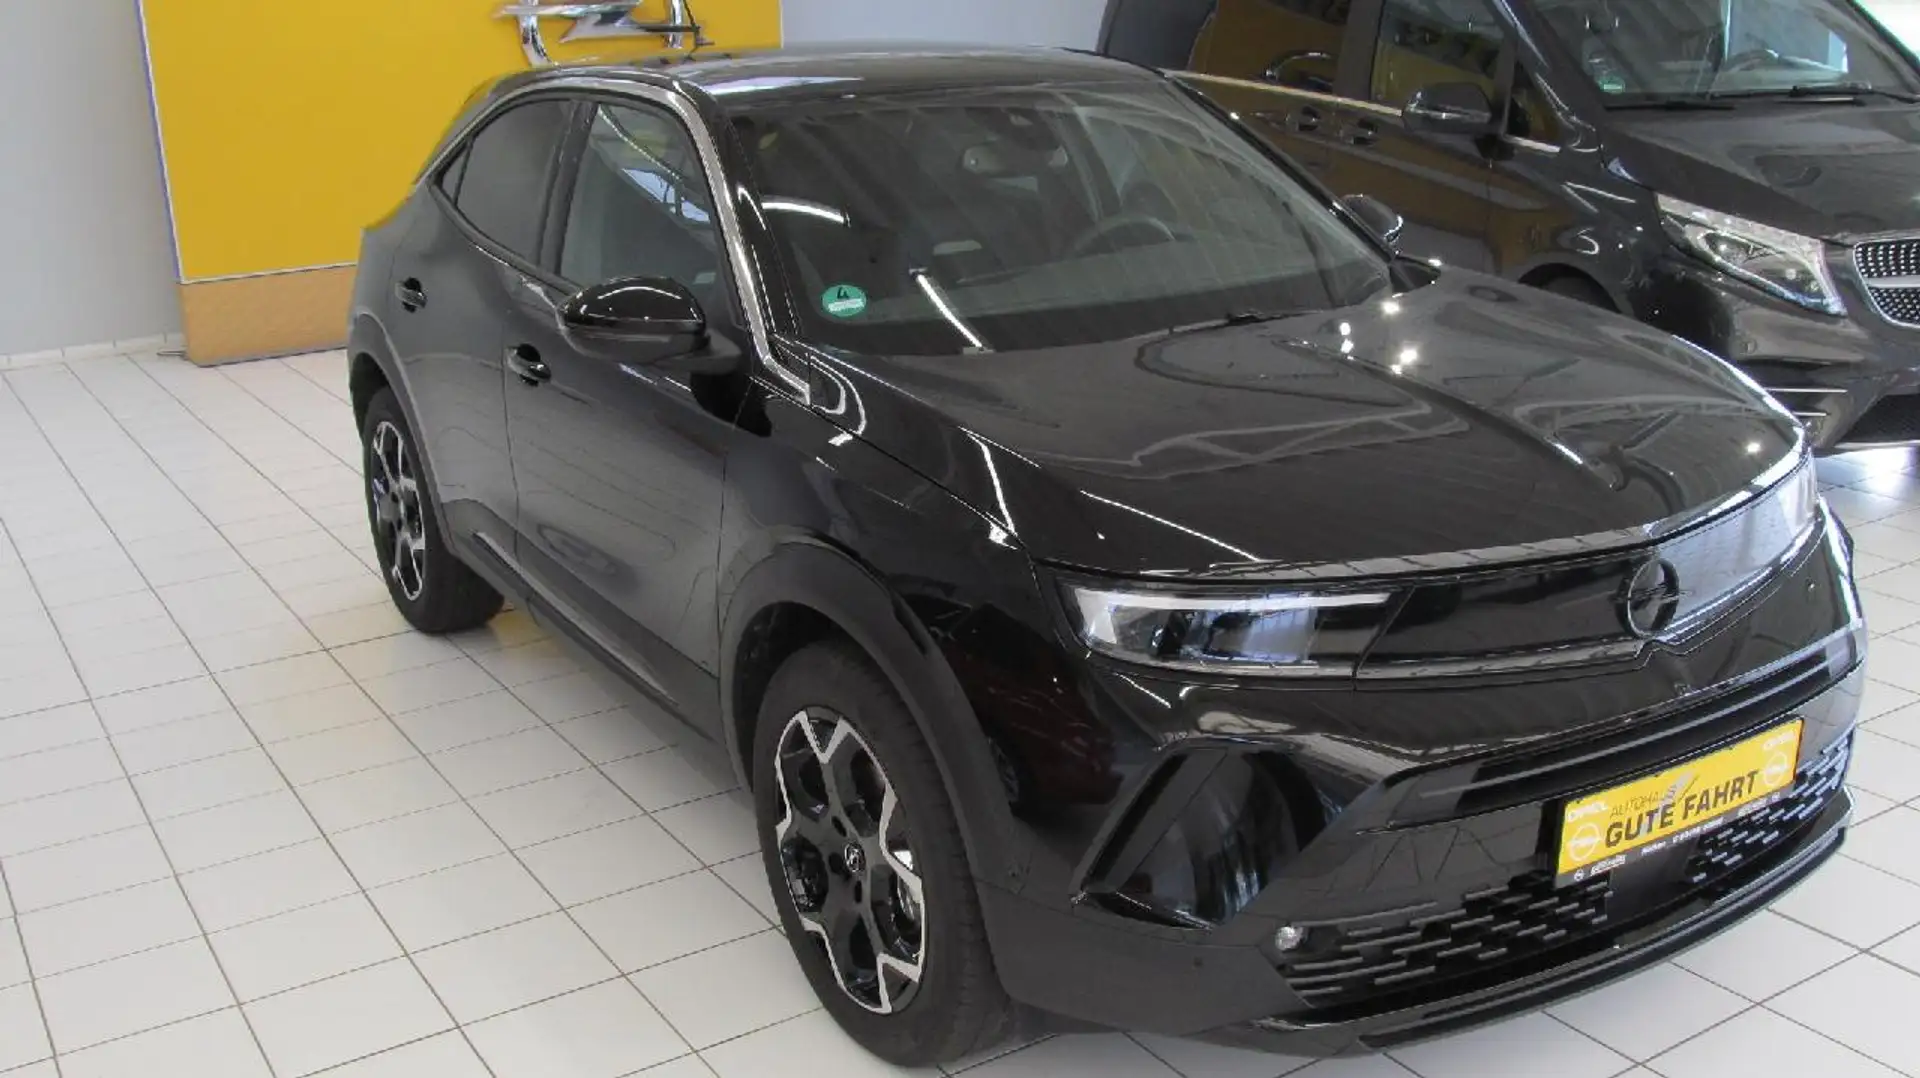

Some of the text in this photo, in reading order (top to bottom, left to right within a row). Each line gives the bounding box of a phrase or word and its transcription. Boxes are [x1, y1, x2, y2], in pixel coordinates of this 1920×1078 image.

[836, 286, 849, 300] 4
[1605, 803, 1676, 848] GUTE
[1683, 770, 1759, 820] FAHRT
